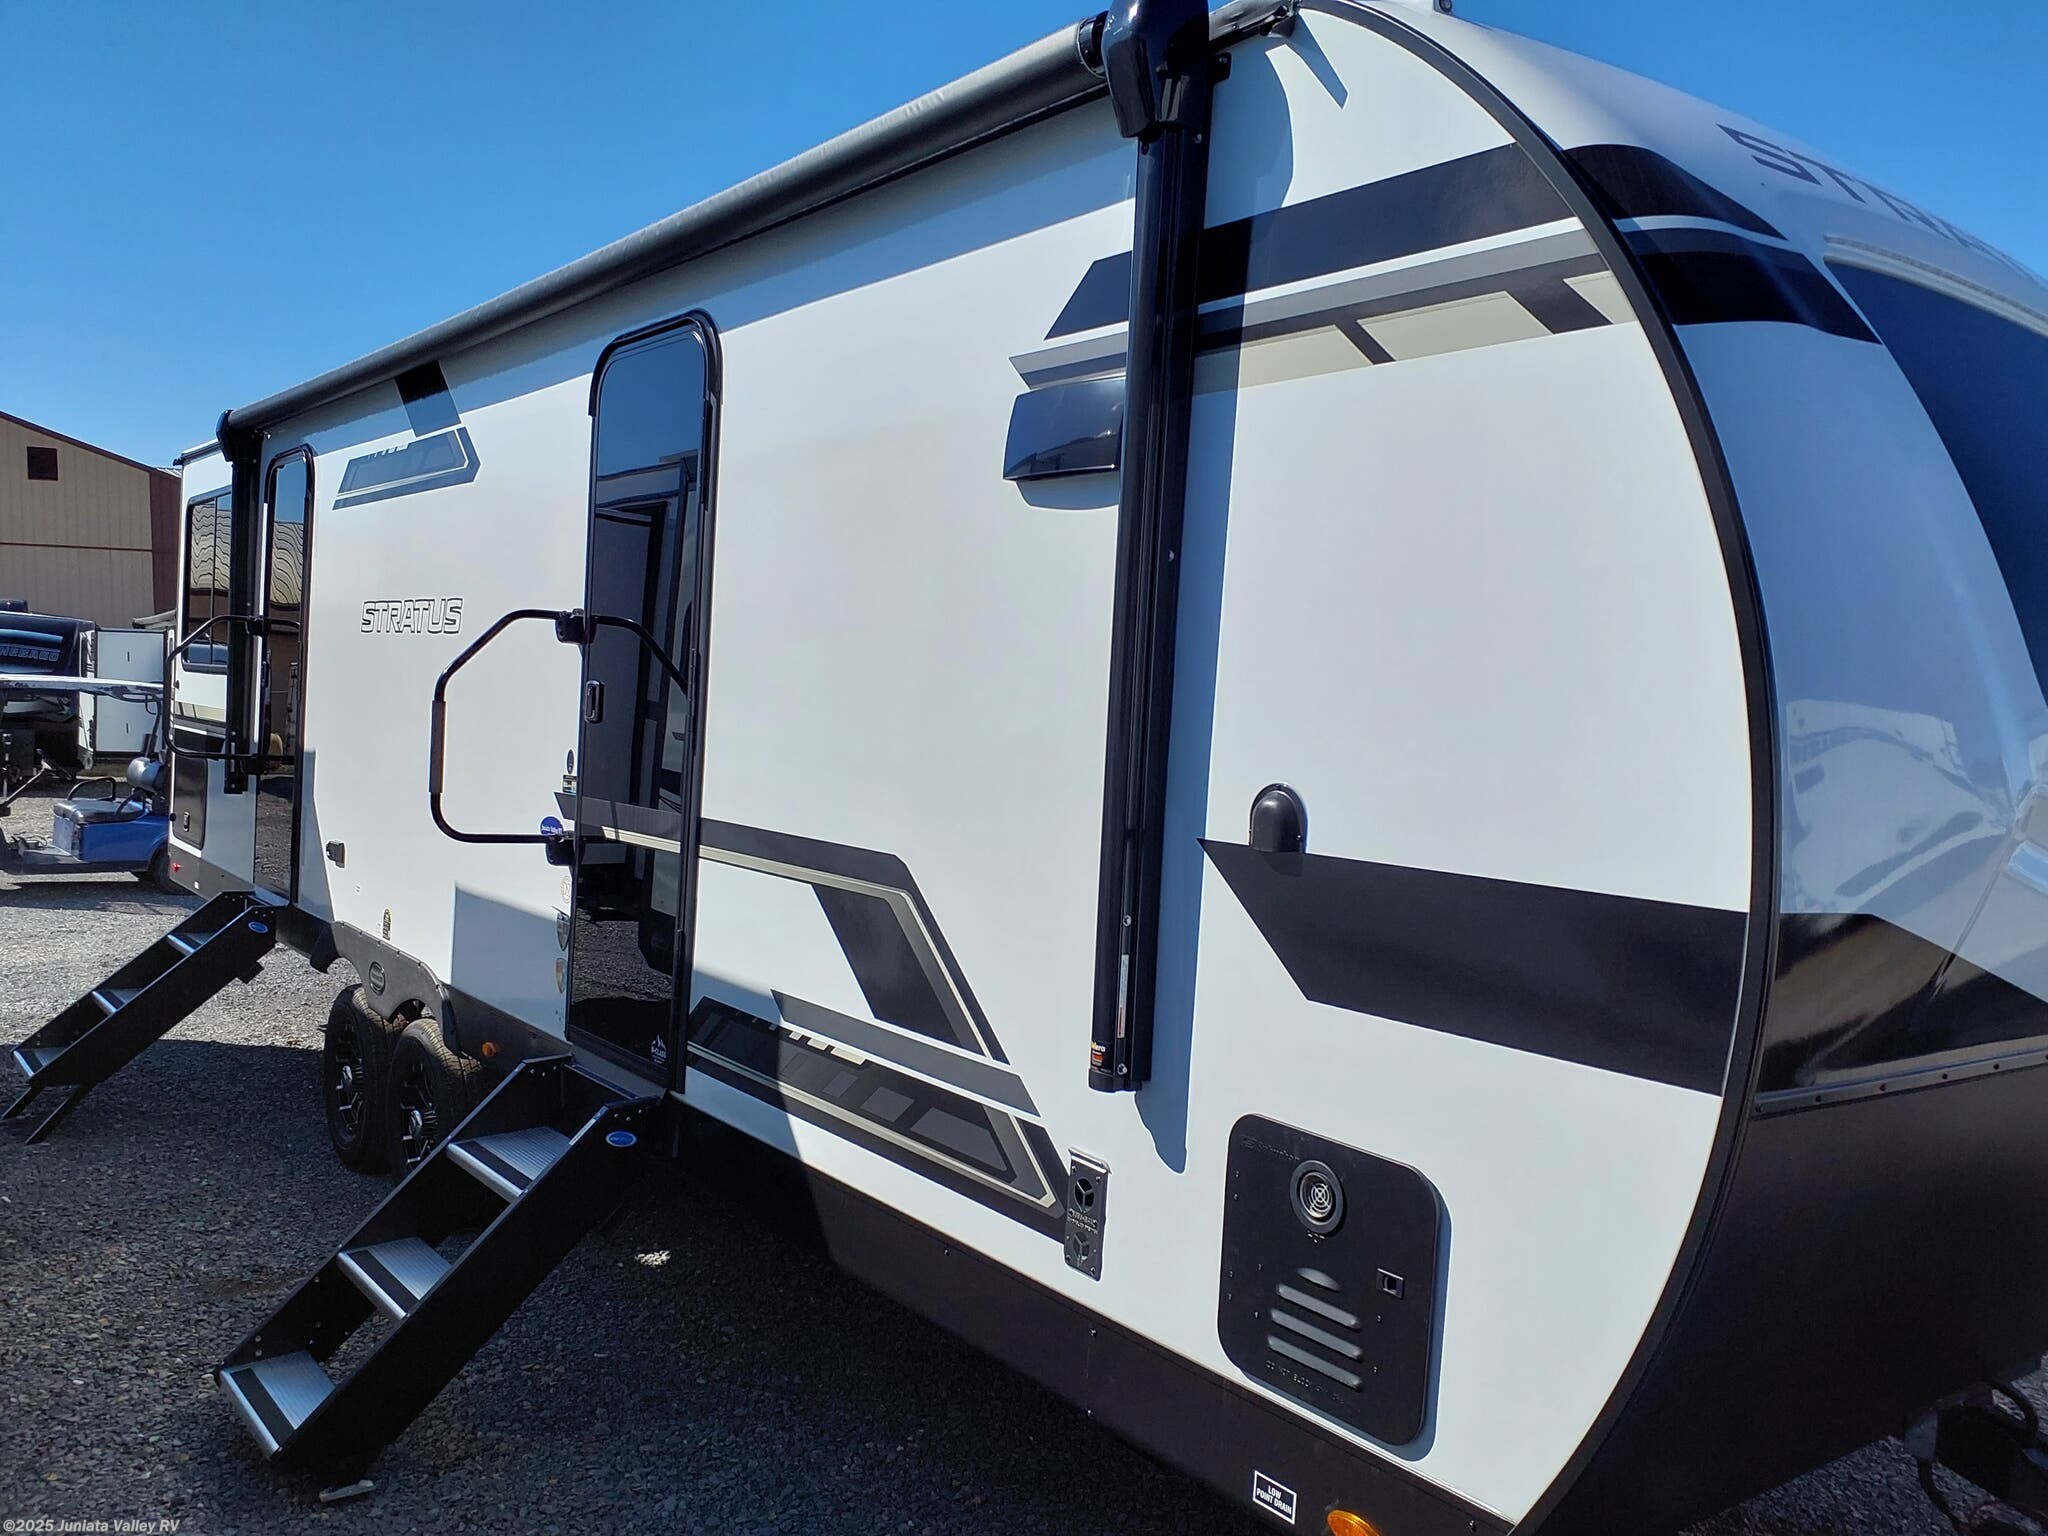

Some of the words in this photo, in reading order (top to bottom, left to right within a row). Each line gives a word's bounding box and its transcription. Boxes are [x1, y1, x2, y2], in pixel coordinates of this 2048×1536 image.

[361, 598, 464, 635] STRATUS
[1257, 1488, 1274, 1504] POINT
[1274, 1498, 1292, 1515] DRAIN
[1268, 1485, 1282, 1500] LOW
